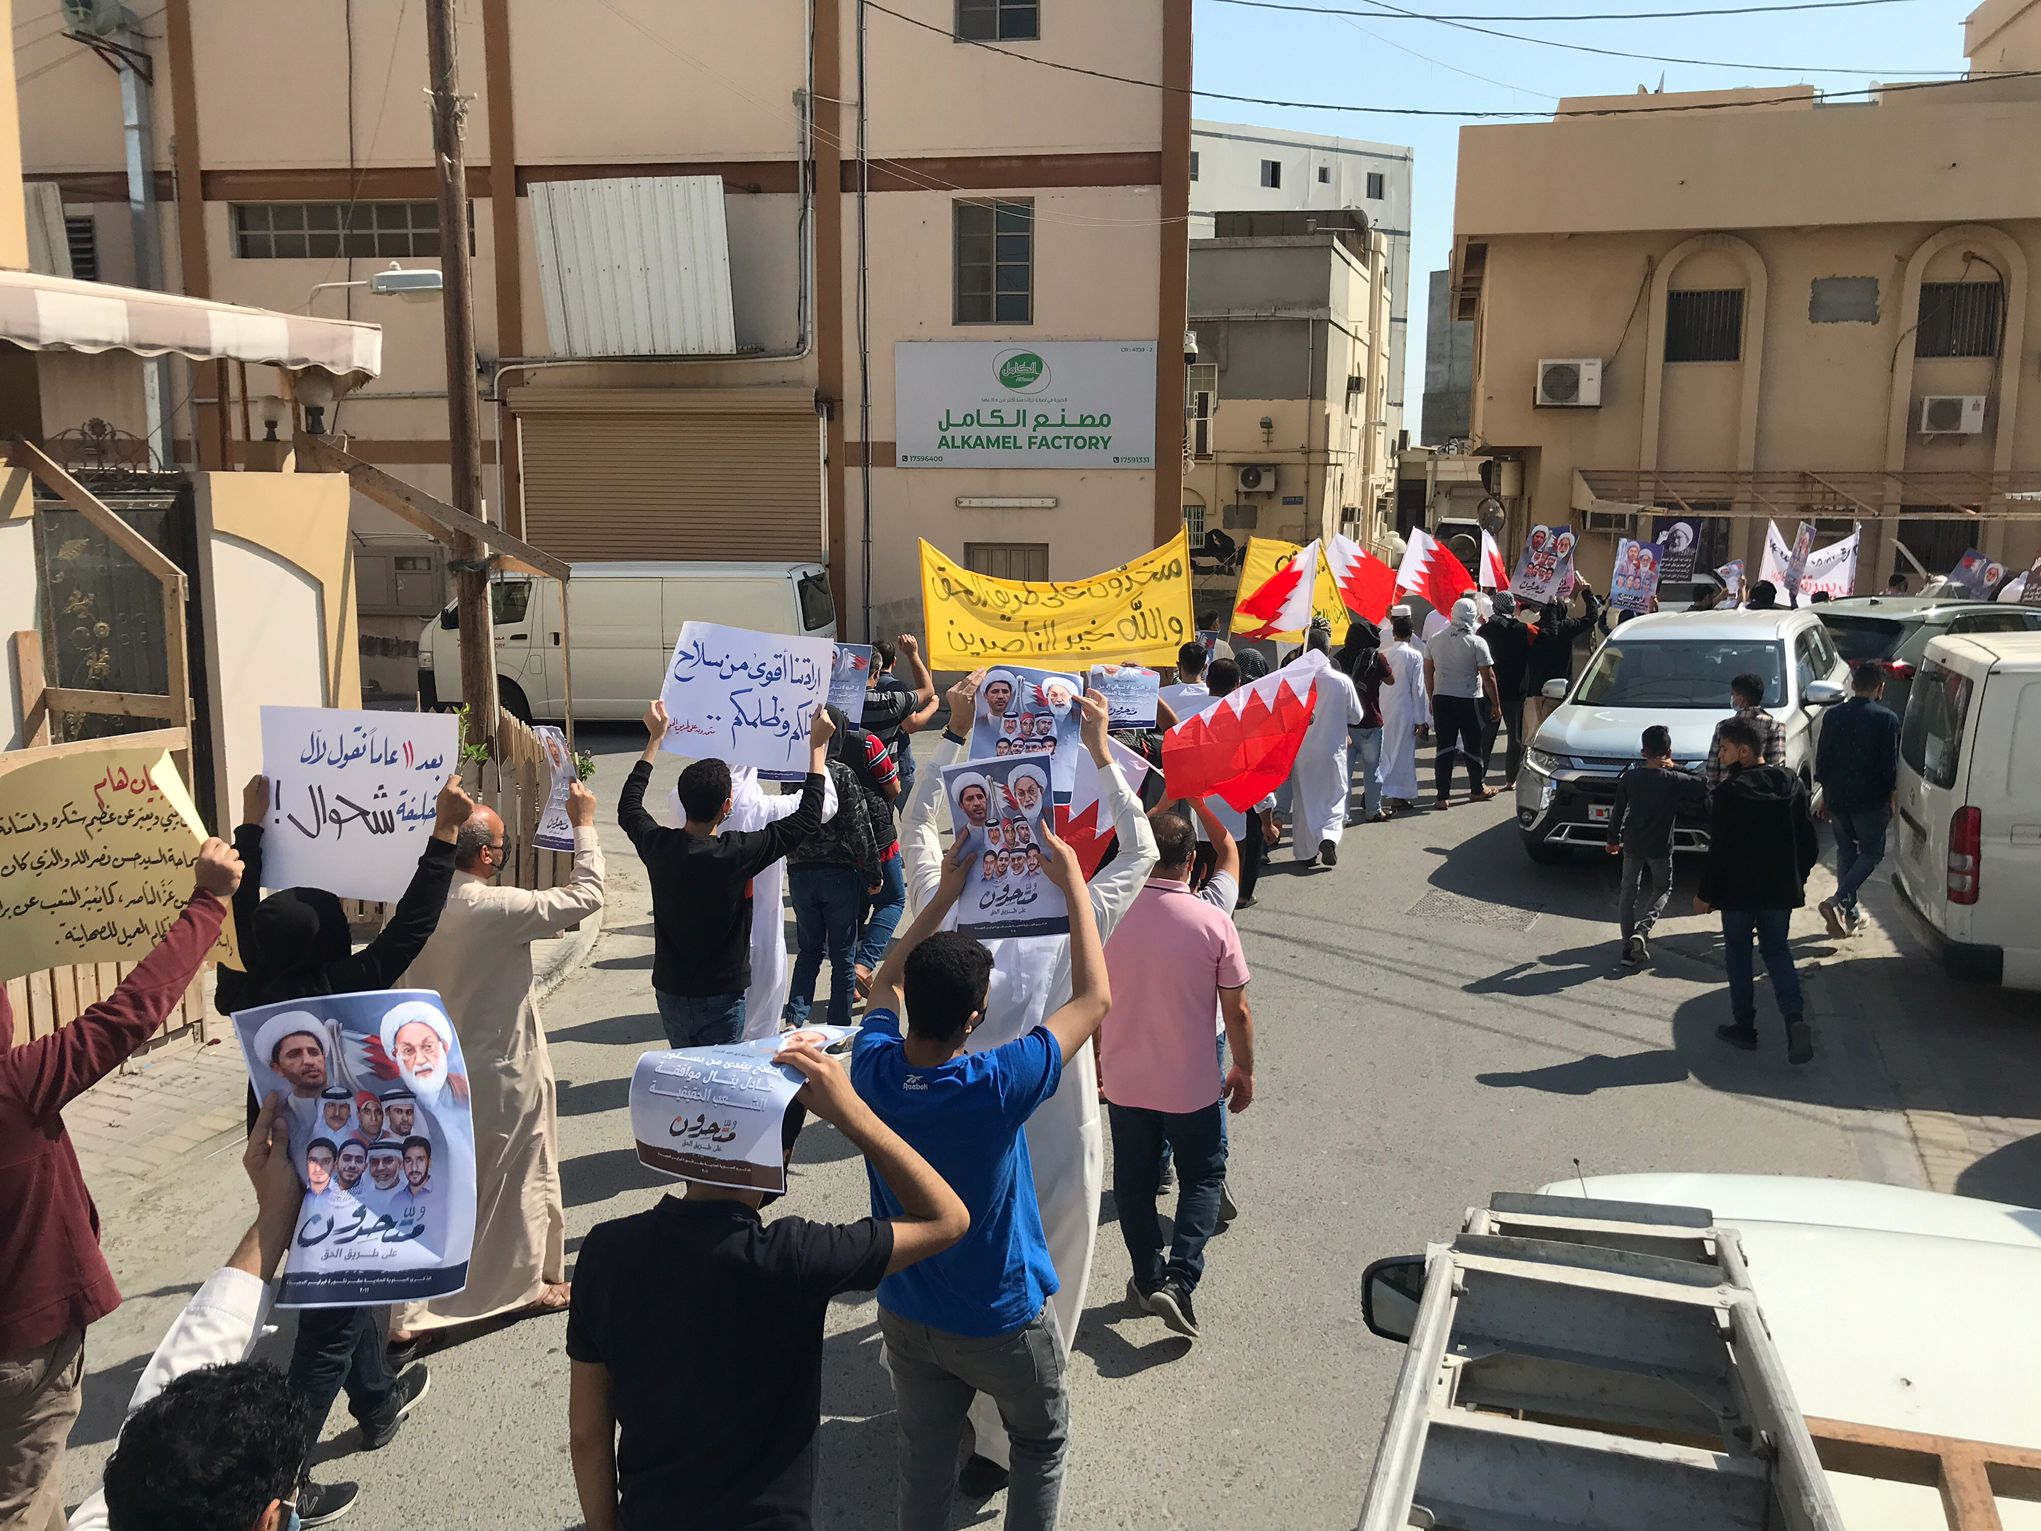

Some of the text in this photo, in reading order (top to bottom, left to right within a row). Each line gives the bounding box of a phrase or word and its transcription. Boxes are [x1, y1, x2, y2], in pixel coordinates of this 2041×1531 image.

[1002, 361, 1038, 377] الكامل
[938, 408, 1112, 433] مصنع الكامل
[937, 435, 1112, 450] ALKAMEL FACTORY
[932, 566, 987, 607] الحق
[986, 578, 1039, 621] طريق
[1041, 582, 1086, 608] على
[947, 619, 1057, 656] الناصرين
[1063, 619, 1115, 652] خير
[673, 639, 724, 683] سلاح
[718, 653, 749, 680] من
[728, 687, 791, 750] وظلمكم
[327, 726, 367, 769] نقول
[415, 753, 444, 782] بعد
[93, 764, 129, 808] هام
[52, 800, 87, 829] شكره
[84, 801, 117, 840] عظيم
[117, 808, 136, 826] عن
[0, 850, 31, 878] كان
[30, 847, 70, 878] والذي
[70, 848, 90, 868] الله
[86, 845, 111, 868] نصر
[111, 851, 142, 870] حسن
[141, 847, 168, 870] السيد
[13, 896, 40, 917] عن
[40, 885, 81, 915] الشعب
[117, 917, 150, 945] العميل
[705, 1057, 722, 1066] من
[654, 1061, 775, 1092] عادل ينال موافقة
[902, 1082, 928, 1091] Reebok
[320, 1247, 398, 1261] على طريق الحق
